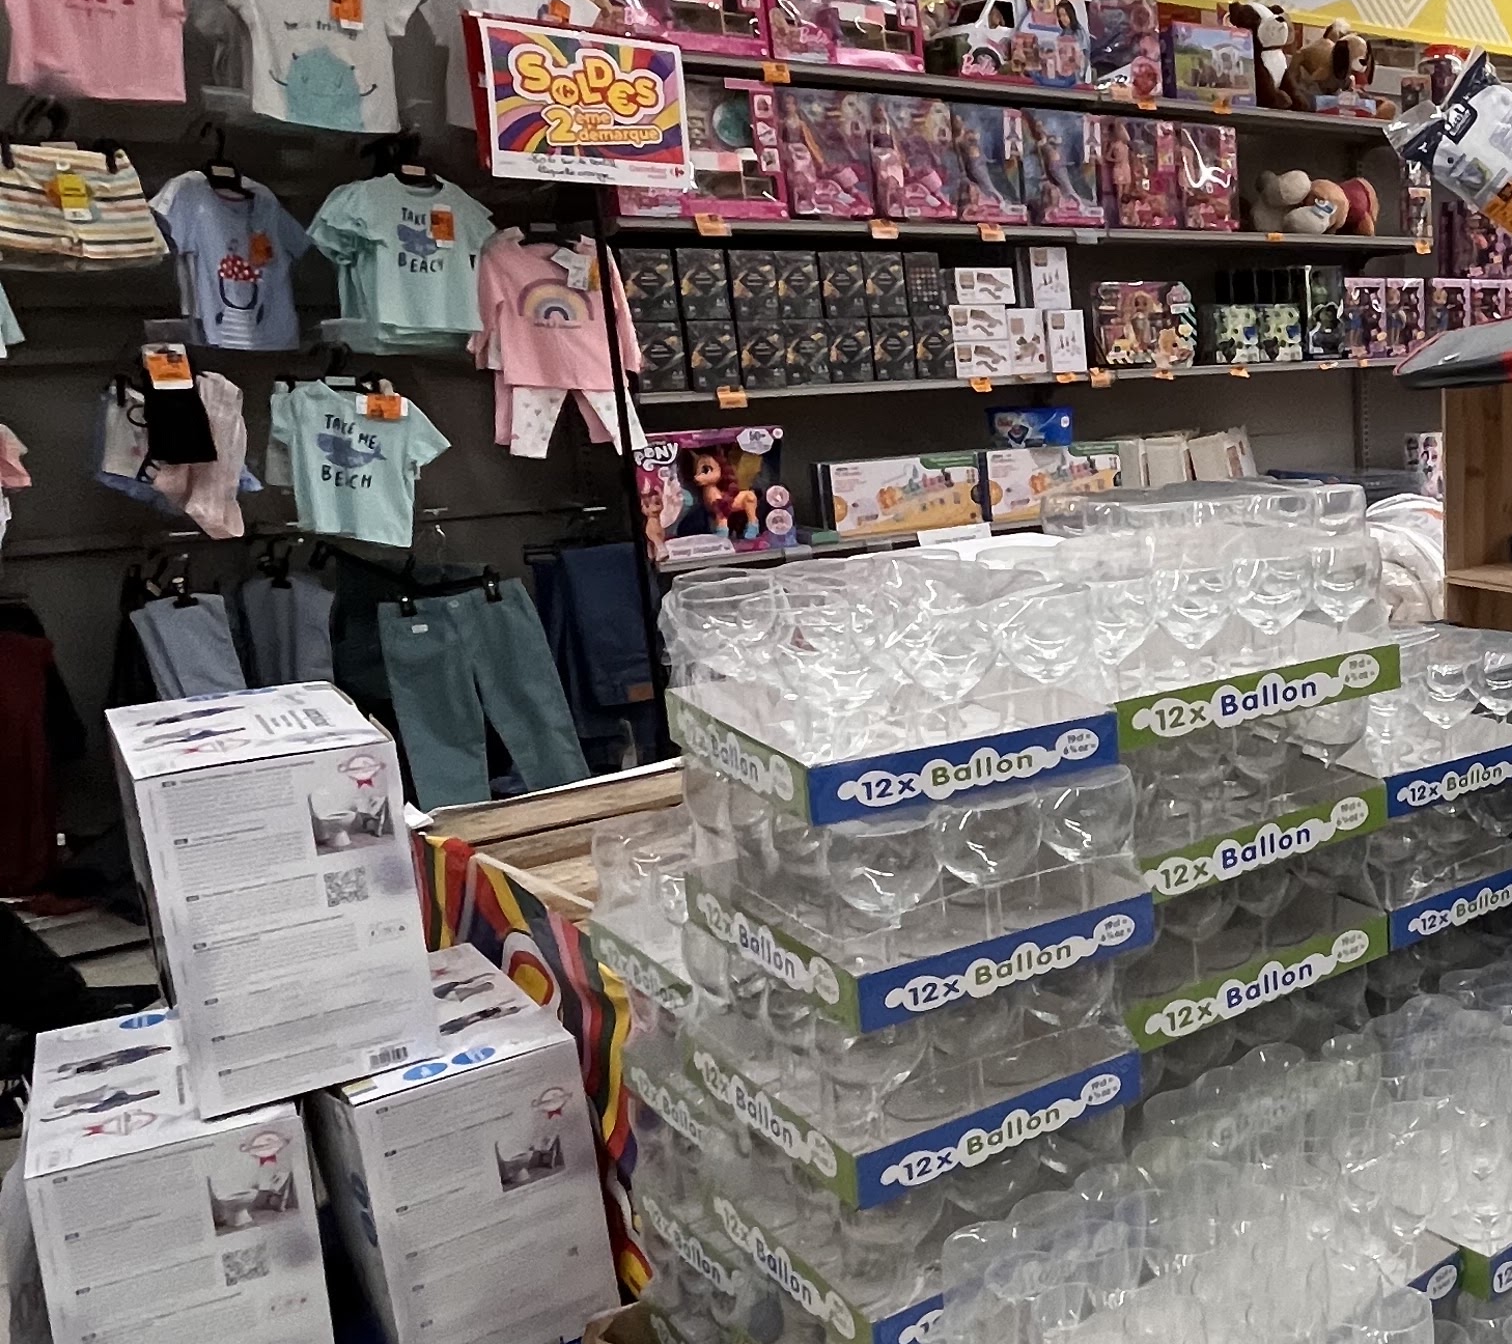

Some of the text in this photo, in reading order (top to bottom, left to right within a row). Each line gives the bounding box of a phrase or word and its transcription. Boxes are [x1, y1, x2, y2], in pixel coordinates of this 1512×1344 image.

[515, 50, 659, 117] SOLDES
[358, 433, 377, 449] ME
[321, 464, 372, 490] BECH
[1155, 680, 1317, 731] 12x Ballon
[862, 754, 1033, 801] 12x Ballon
[1410, 765, 1503, 802] 12x Ballon
[1160, 827, 1311, 890] 12x Ballon
[1421, 888, 1511, 932] 12x Ballon
[738, 924, 796, 979] Ballon
[907, 943, 1072, 1007] 12x Ballon
[1166, 962, 1313, 1032] 12x Ballon
[662, 1094, 697, 1137] Ballo
[735, 1085, 793, 1148] Ballon
[902, 1107, 1060, 1181] 12x Ballon
[756, 1237, 812, 1306] Ballon
